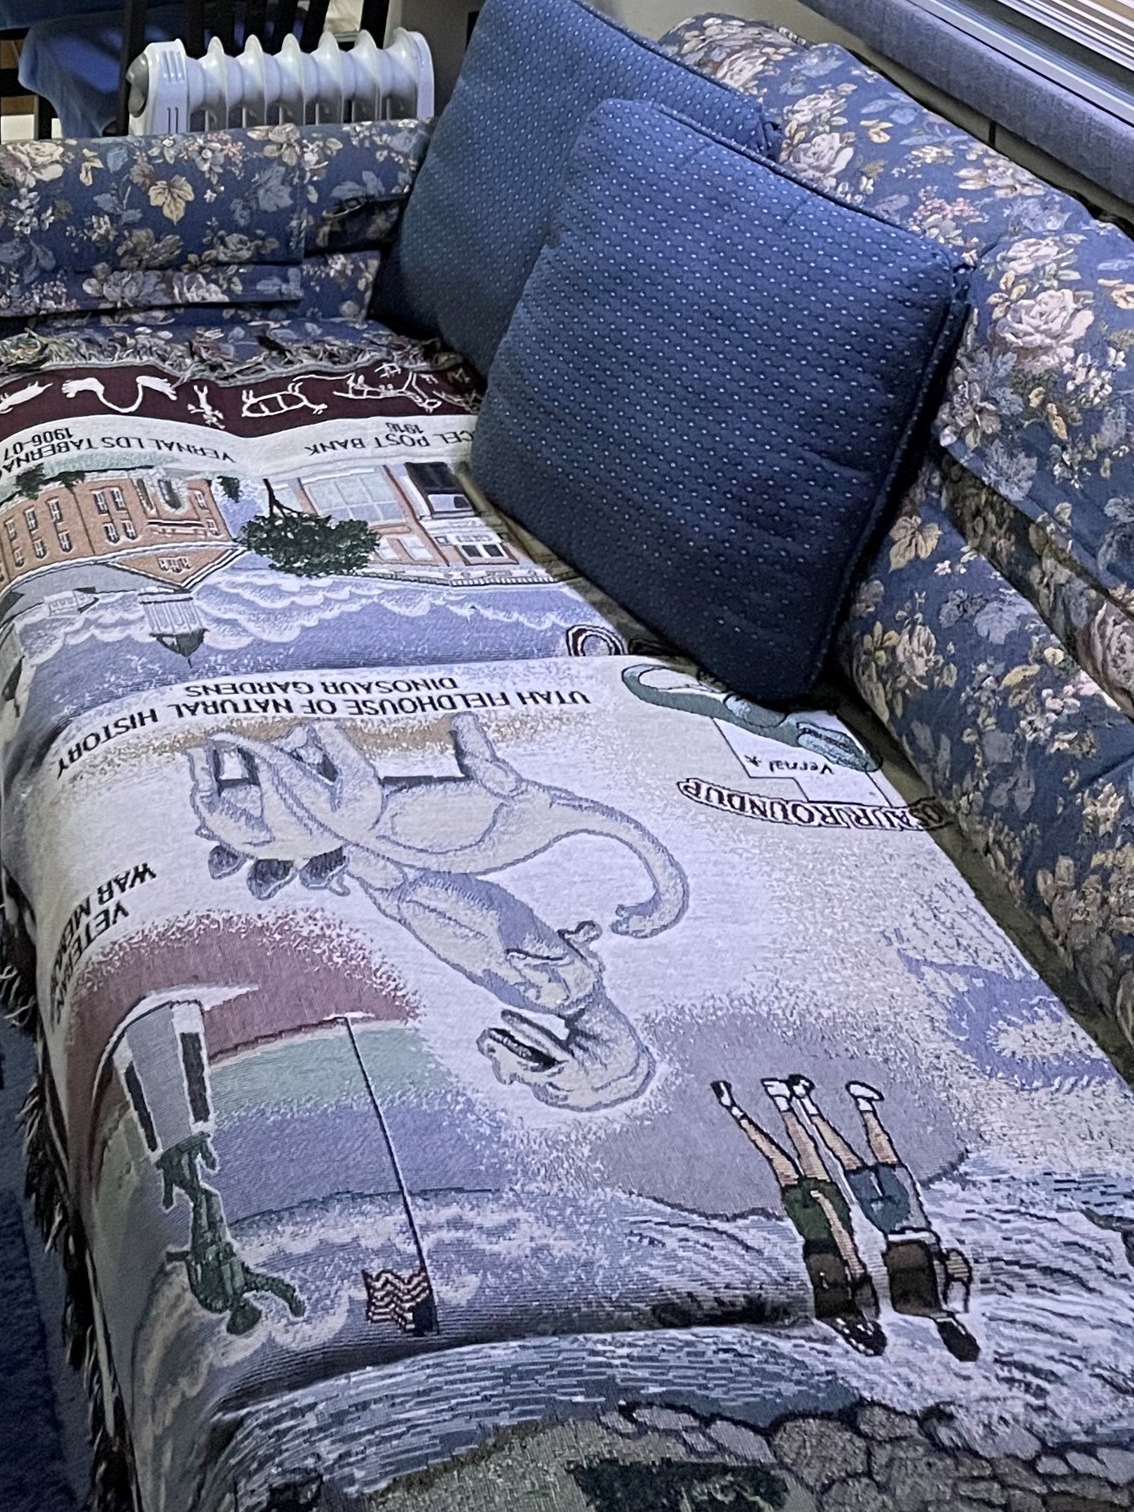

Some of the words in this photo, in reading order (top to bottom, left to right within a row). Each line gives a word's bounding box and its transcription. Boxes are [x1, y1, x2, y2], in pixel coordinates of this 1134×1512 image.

[3, 426, 74, 462] 1906-07
[101, 436, 145, 450] LDS
[374, 433, 430, 449] POST
[433, 430, 475, 445] CEL
[147, 437, 236, 464] VERNAL
[304, 438, 366, 456] BANK
[185, 680, 314, 697] GARDENS
[320, 677, 459, 695] DINOSAUR
[301, 698, 338, 715] OF
[346, 691, 511, 716] FIELDHOUSE
[516, 690, 591, 706] UTAH
[167, 698, 294, 718] NATURAL
[57, 708, 159, 780] HISTORY
[768, 760, 835, 776] Vernal
[682, 780, 849, 828] ROUNDUP
[96, 862, 157, 906] WAR
